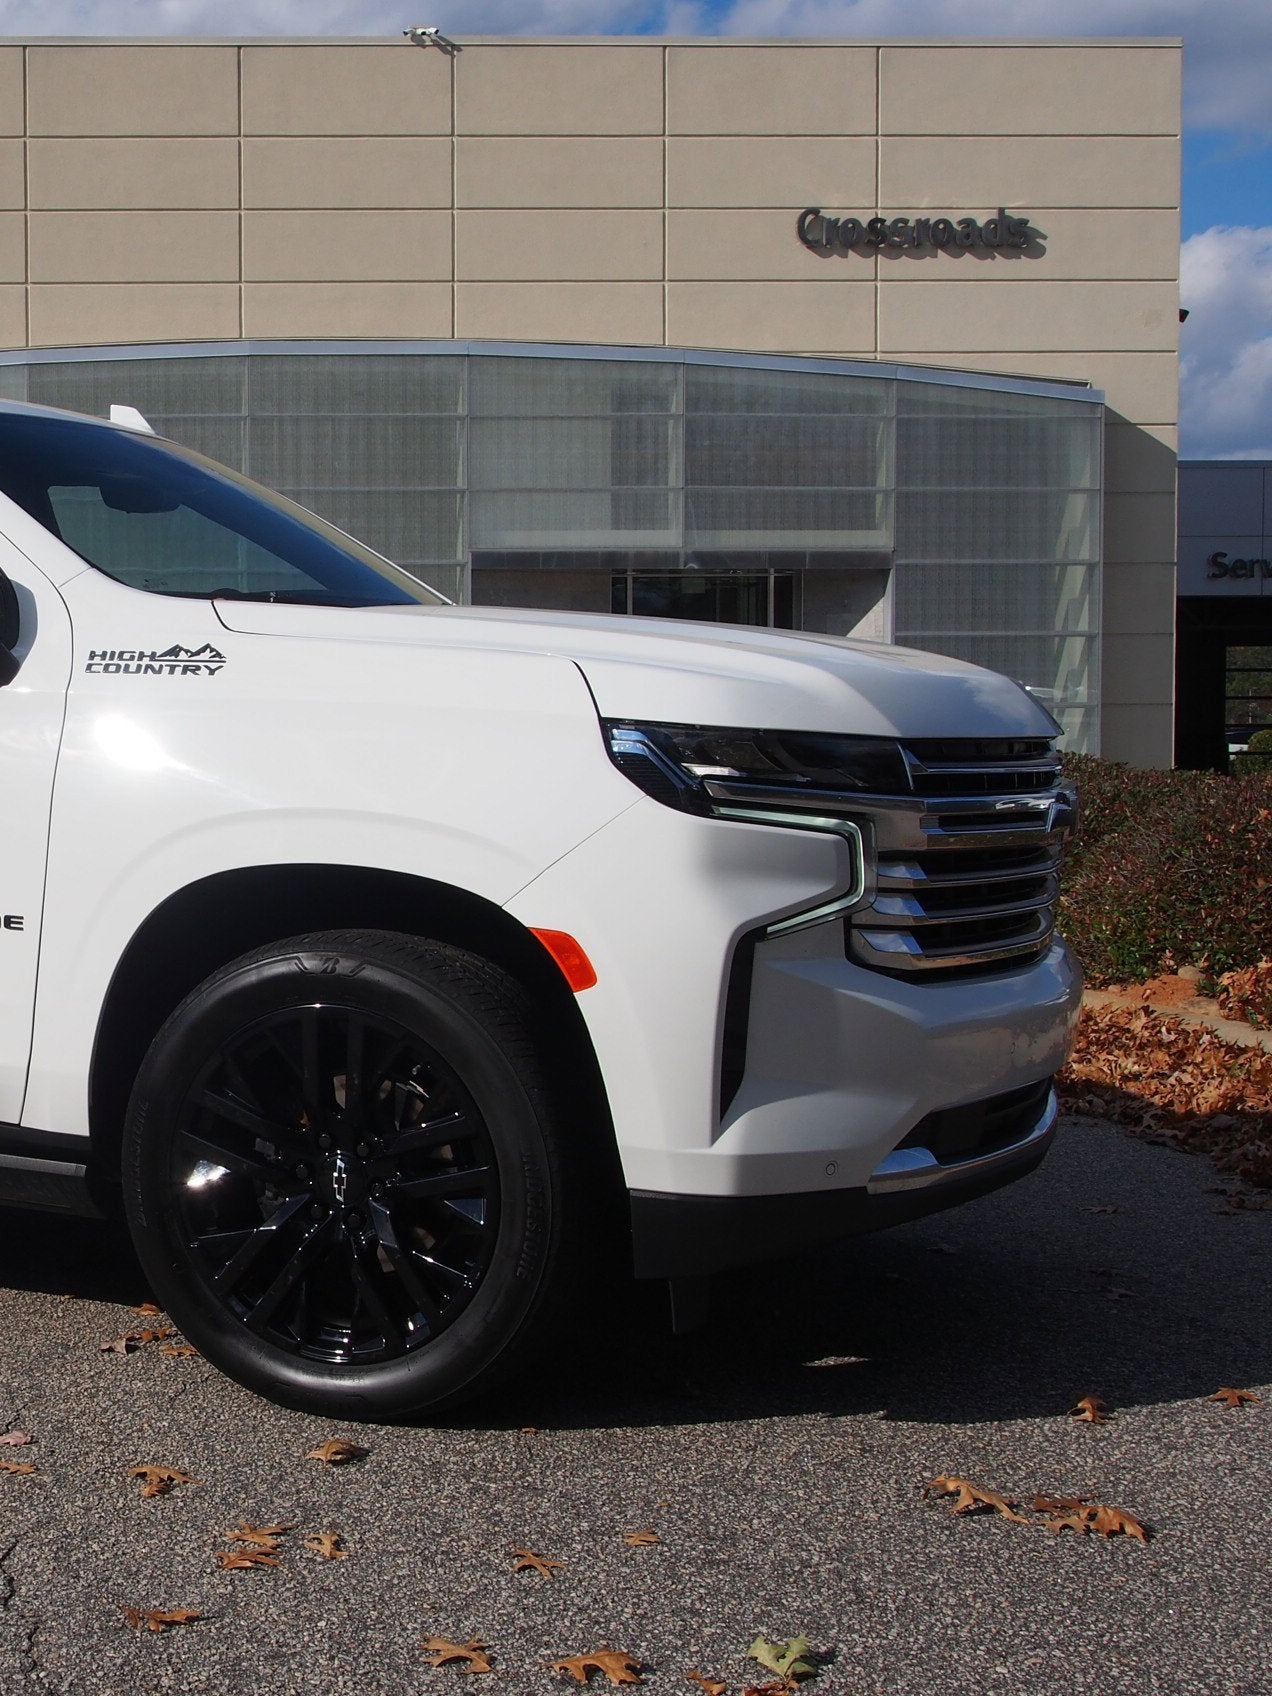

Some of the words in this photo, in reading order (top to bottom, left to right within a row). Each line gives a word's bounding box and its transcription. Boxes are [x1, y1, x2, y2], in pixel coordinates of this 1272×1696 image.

[797, 207, 1030, 249] Crossroads
[88, 650, 158, 662] HIGH
[85, 663, 224, 676] COUNTRY
